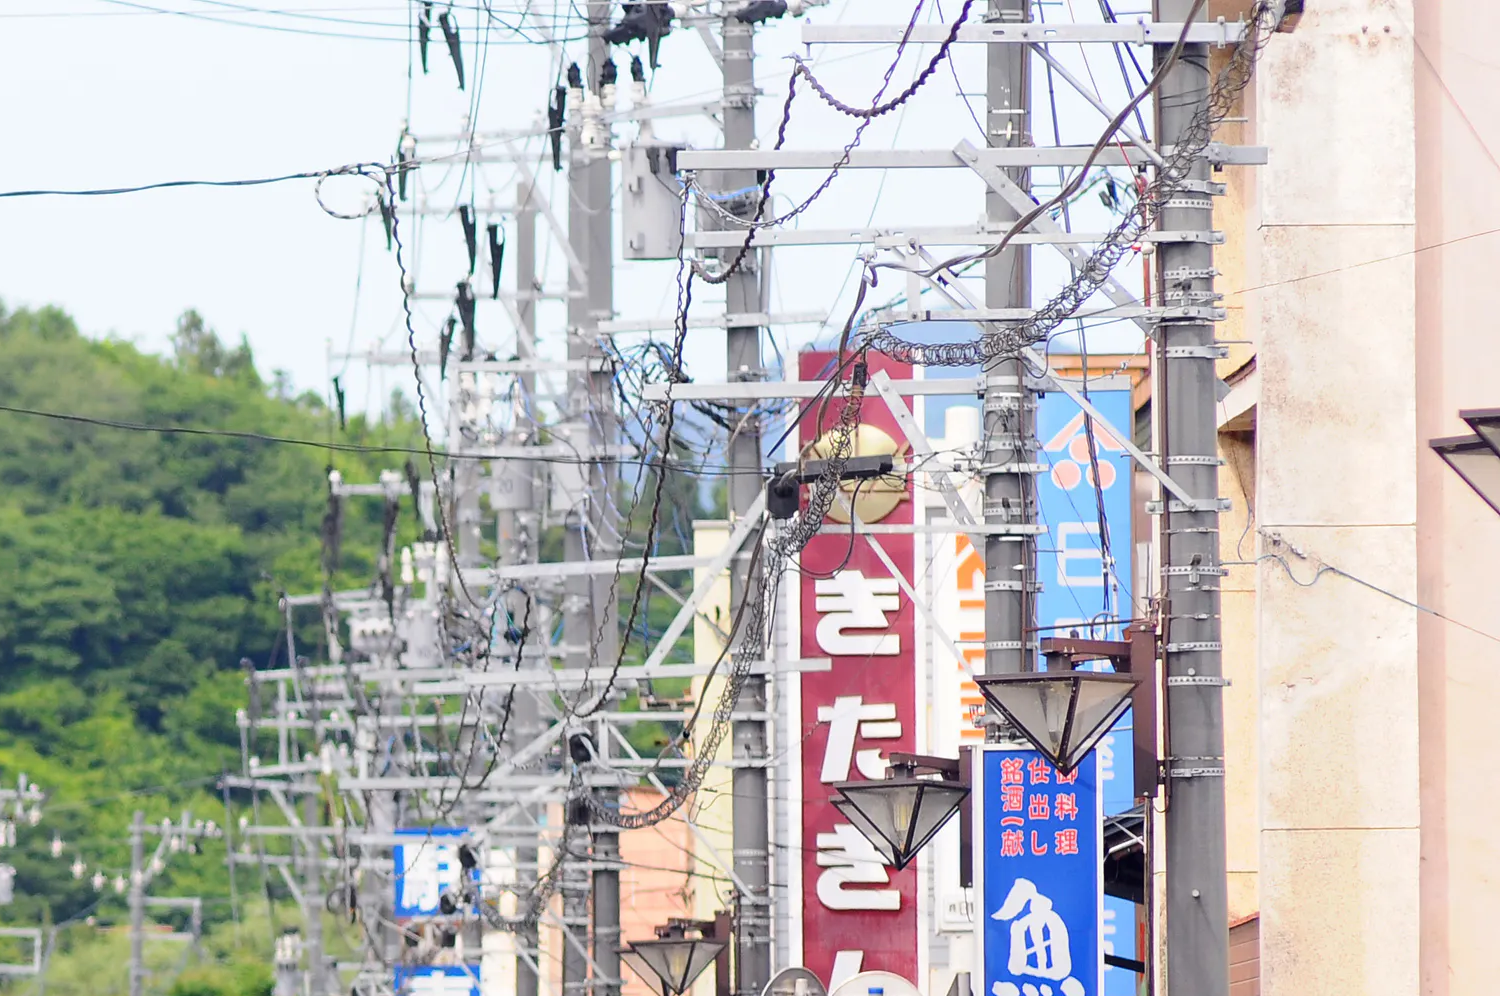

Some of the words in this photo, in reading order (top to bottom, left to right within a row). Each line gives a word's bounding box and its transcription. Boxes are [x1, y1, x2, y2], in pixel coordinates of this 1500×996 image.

[1000, 758, 1024, 856] 銘酒一献
[1028, 758, 1051, 855] 仕出し
